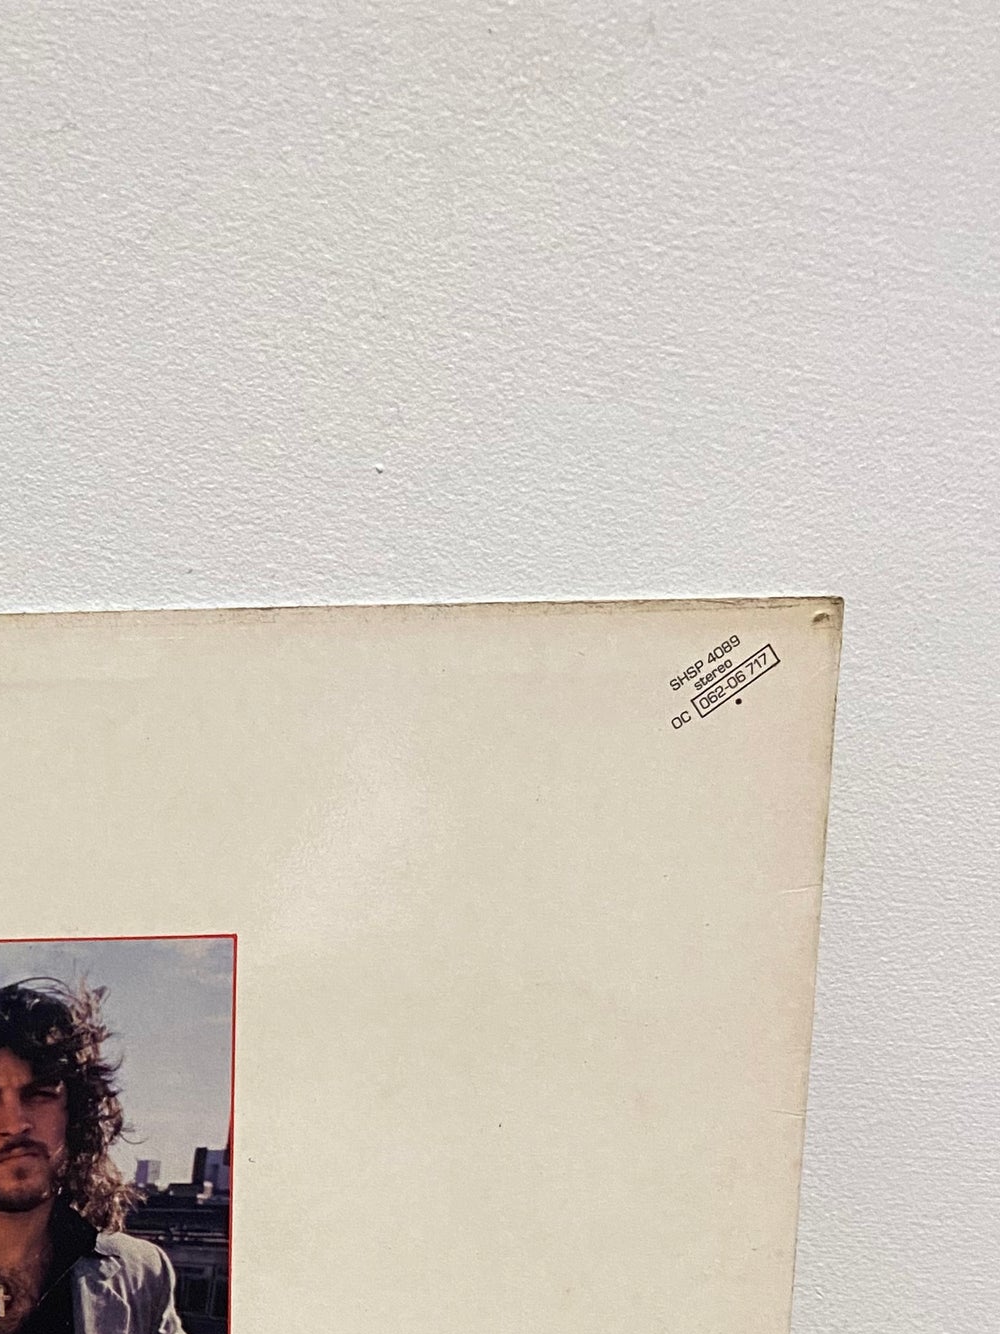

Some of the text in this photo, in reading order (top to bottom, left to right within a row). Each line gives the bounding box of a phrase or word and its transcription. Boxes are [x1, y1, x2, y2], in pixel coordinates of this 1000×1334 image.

[669, 635, 741, 691] SHSP 4089
[671, 652, 767, 730] OC 062-06 717
[694, 659, 733, 691] stereo
